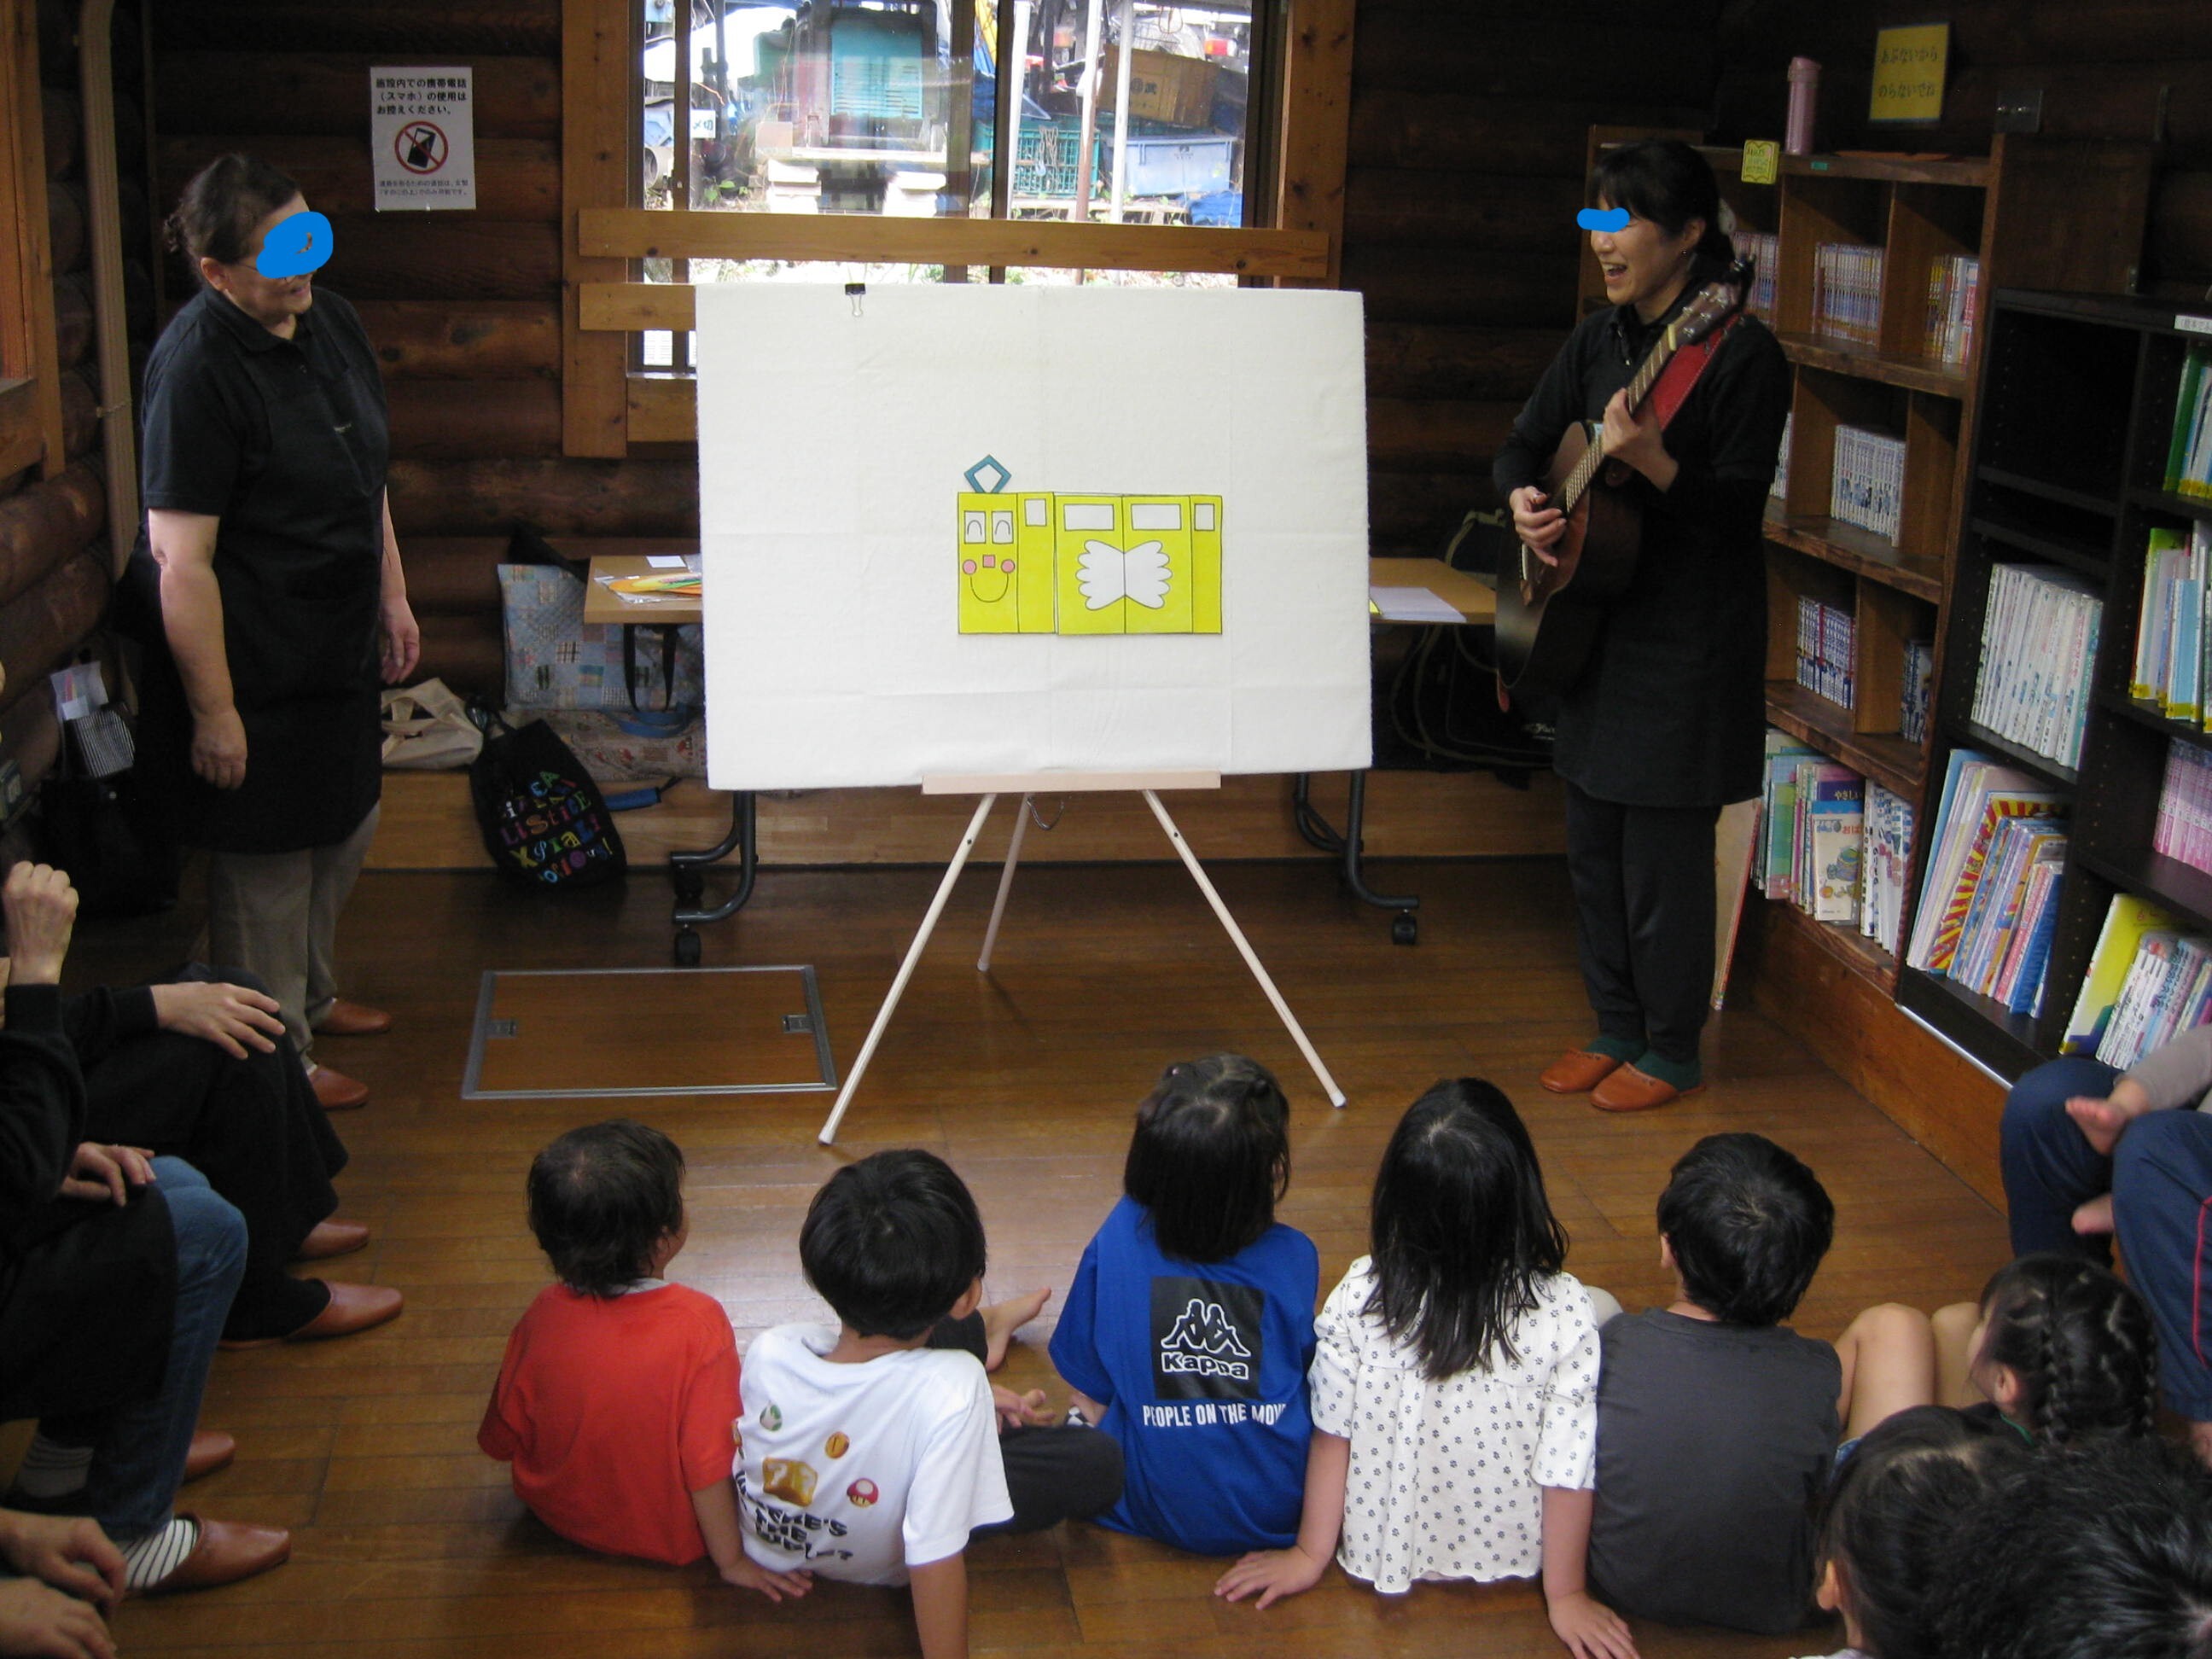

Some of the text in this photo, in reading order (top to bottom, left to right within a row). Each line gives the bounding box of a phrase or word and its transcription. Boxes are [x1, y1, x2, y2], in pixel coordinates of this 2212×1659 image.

[376, 78, 467, 89] 施設内での携帯電話
[376, 105, 451, 115] お控えください。
[1195, 1403, 1218, 1426] ON
[1218, 1403, 1248, 1425] THE
[1251, 1403, 1287, 1426] MOV
